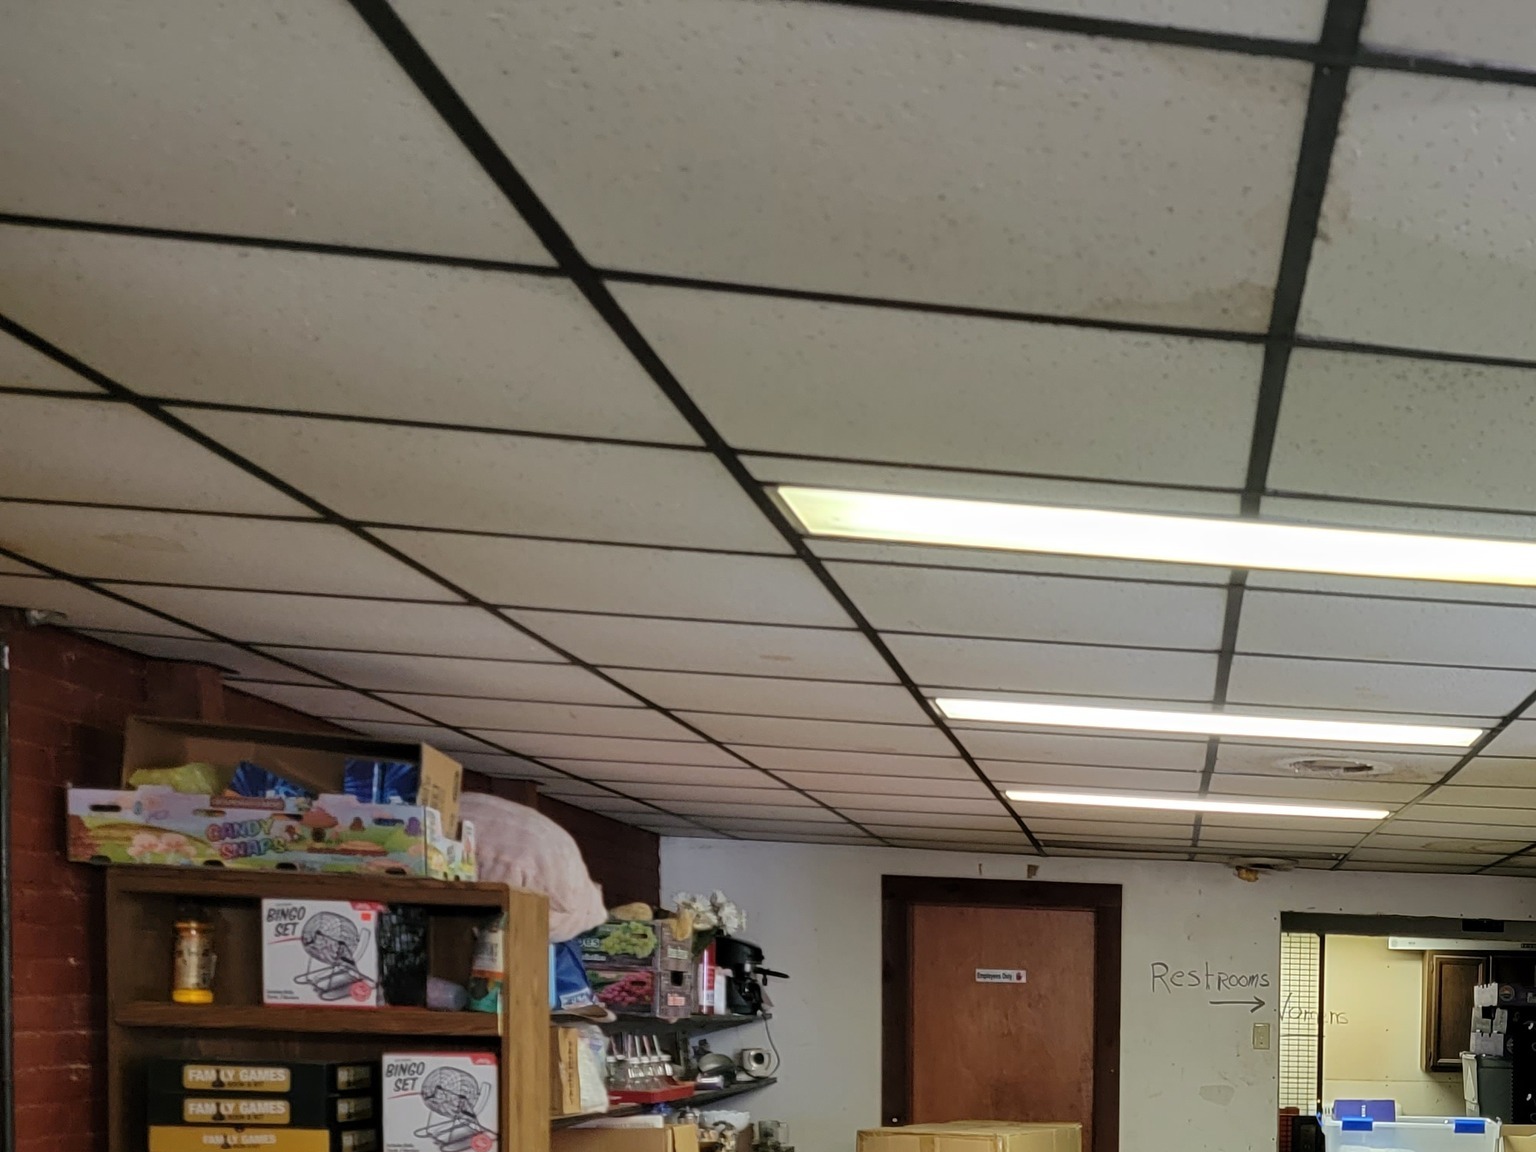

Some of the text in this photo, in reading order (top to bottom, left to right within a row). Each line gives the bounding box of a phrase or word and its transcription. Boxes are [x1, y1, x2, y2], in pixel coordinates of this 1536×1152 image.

[204, 817, 275, 842] CANDY
[266, 907, 306, 922] BINGO
[274, 922, 298, 937] SET
[976, 972, 1012, 980] Employees Only
[240, 1069, 286, 1082] GAMES
[386, 1062, 425, 1078] BINGO
[394, 1077, 418, 1092] SET
[240, 1102, 286, 1114] GAMES
[240, 1134, 277, 1144] GAMES
